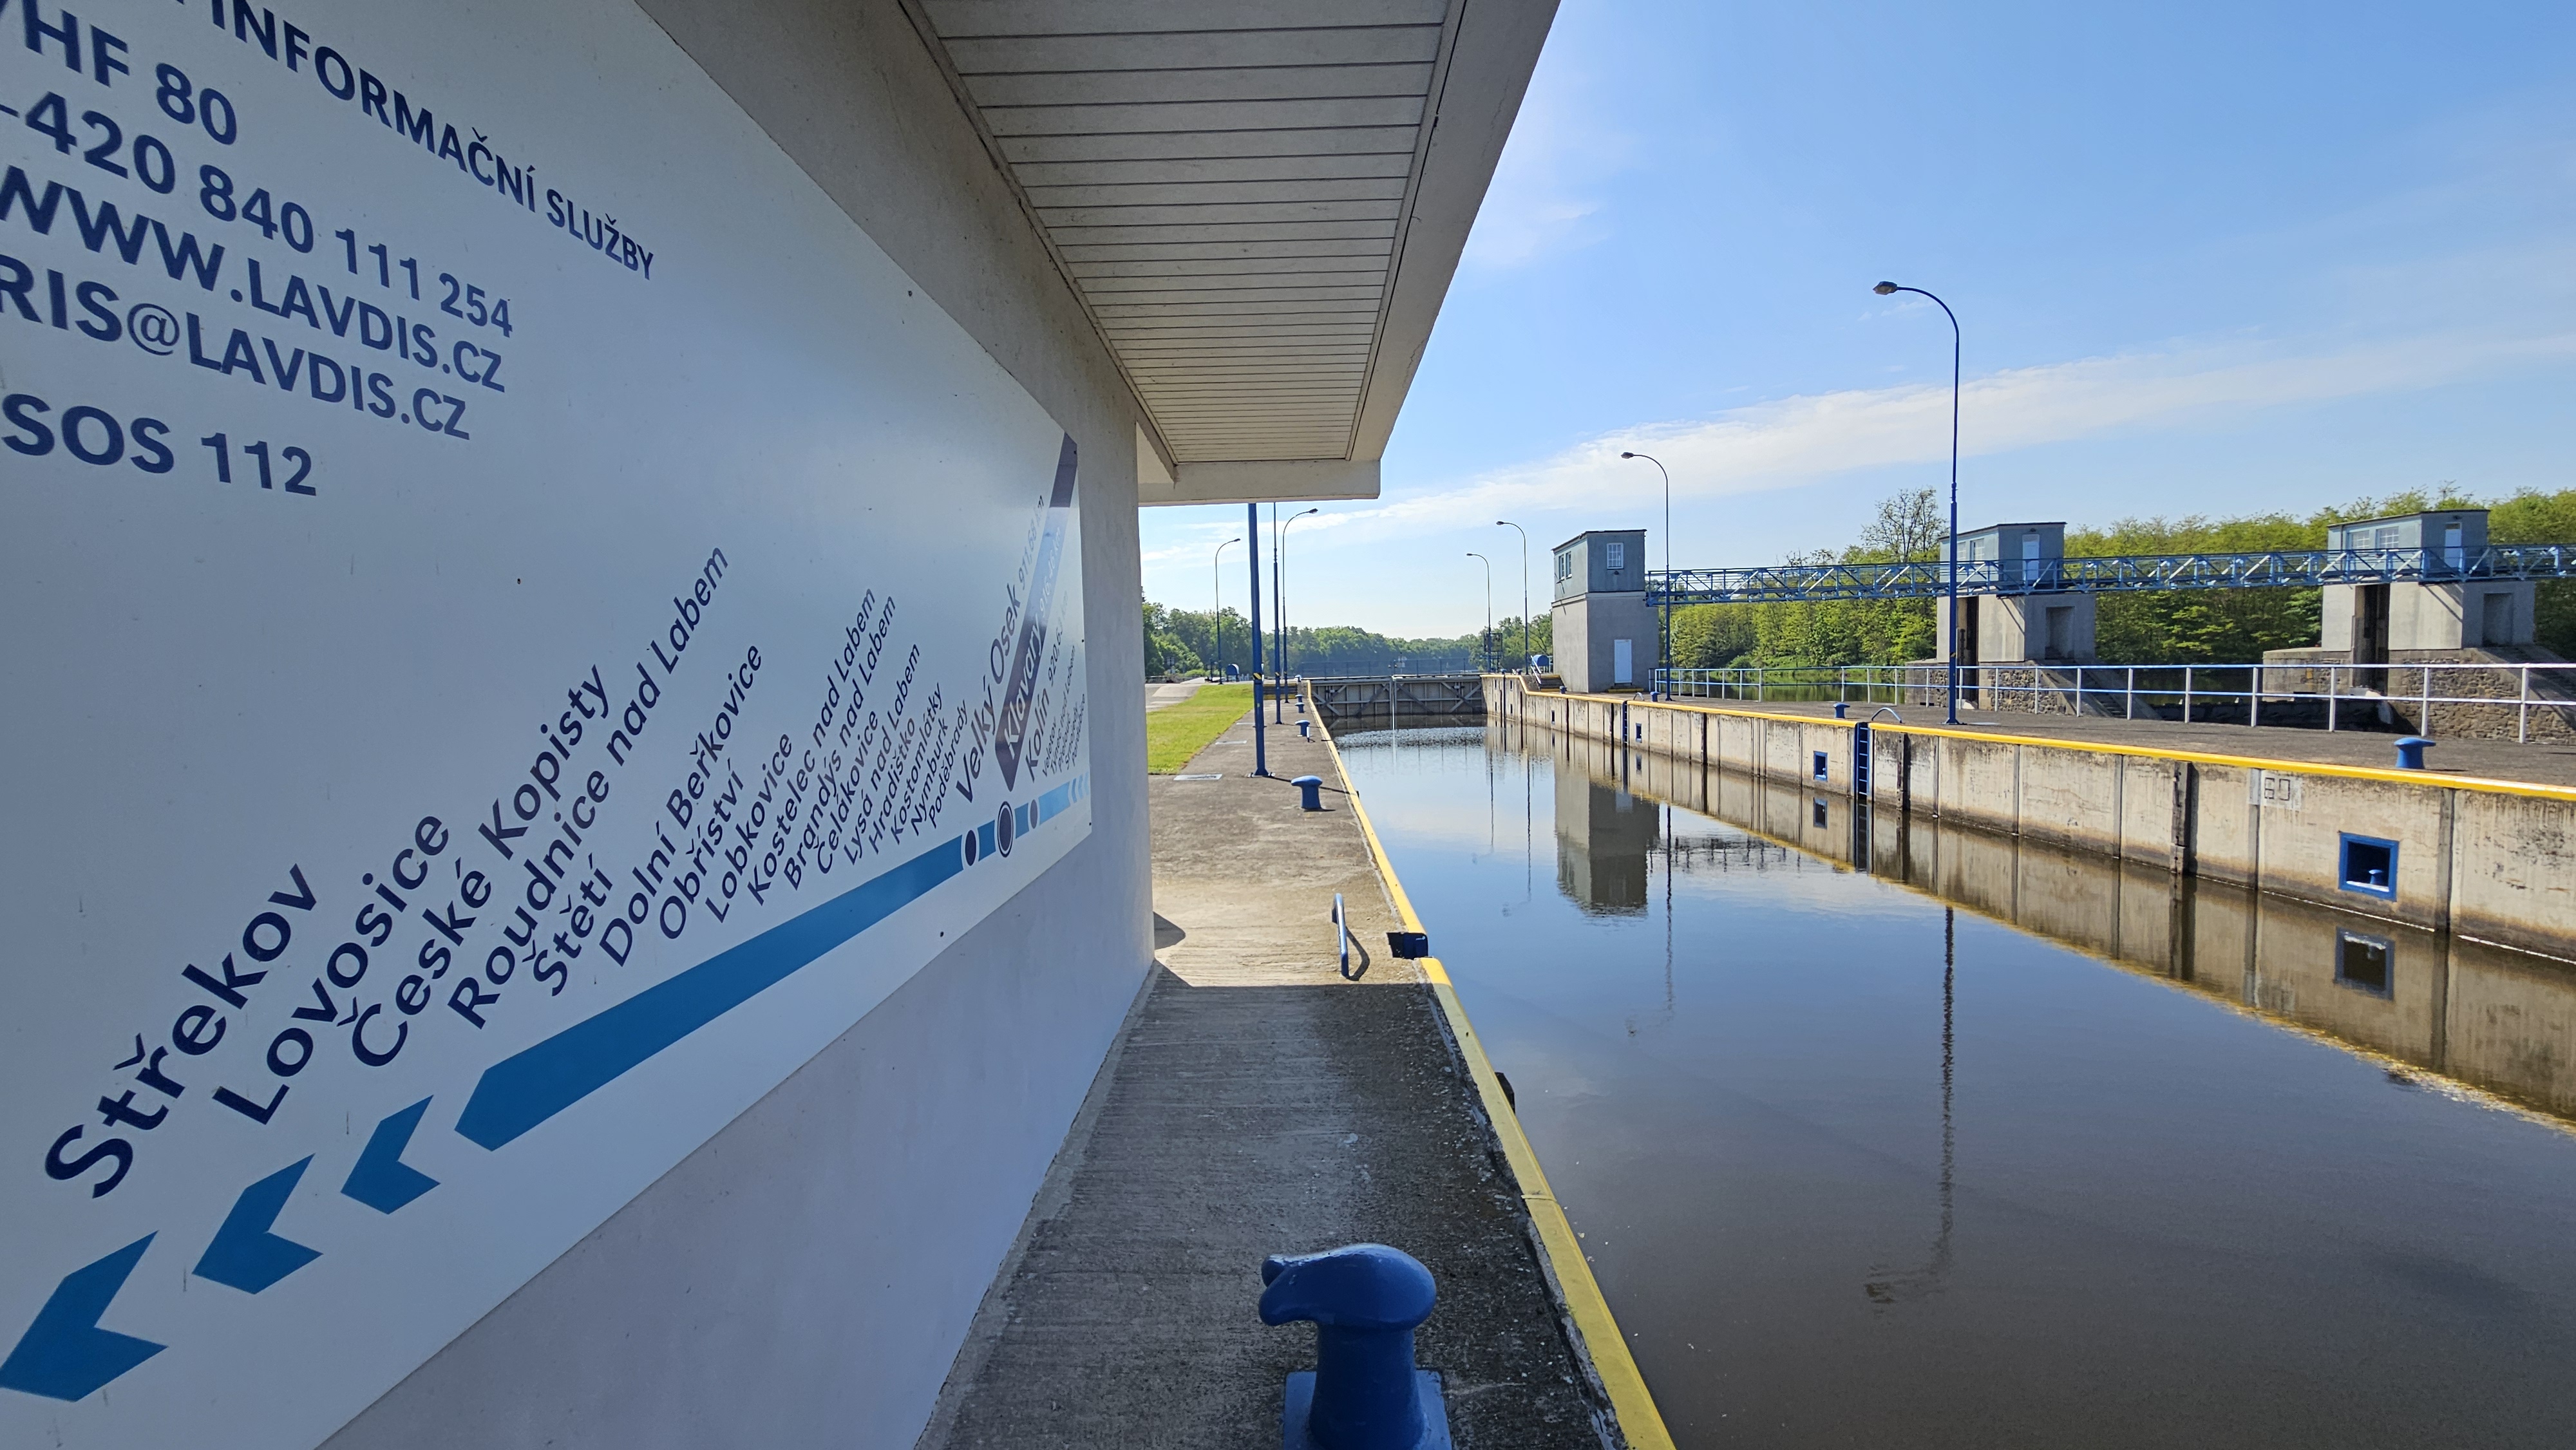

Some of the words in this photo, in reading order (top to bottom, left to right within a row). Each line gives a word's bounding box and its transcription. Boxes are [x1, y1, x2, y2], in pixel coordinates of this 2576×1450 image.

[0, 0, 130, 88] HF
[155, 63, 237, 145] 80
[200, 165, 314, 253] 840
[336, 228, 421, 300] 111
[439, 272, 513, 338] 254
[546, 188, 654, 280] SLUŽBY
[0, 254, 470, 440] RIS@LAVDIS.CZ
[3, 393, 175, 473] SOS
[200, 432, 317, 496] 112
[747, 749, 816, 907] Kostelec
[813, 674, 840, 748] nad
[835, 588, 875, 683] Labem
[783, 749, 841, 890] Brandýs
[839, 678, 864, 748] nad
[859, 596, 896, 686] Labem
[844, 789, 873, 865] Lysá
[870, 725, 891, 792] nad
[887, 644, 920, 731] Labem
[891, 683, 942, 845] Kostomlátky
[928, 699, 967, 829] Poděbrady
[956, 674, 996, 804] Velký
[990, 583, 1021, 684] Osek
[1004, 614, 1043, 760] Klavary
[1026, 688, 1050, 783] Kolín
[447, 769, 609, 1030] Roudnice
[606, 663, 660, 766] nad
[650, 547, 728, 674] Labem
[598, 821, 676, 966] Dolní
[666, 645, 762, 830] Beřkovice
[659, 758, 743, 939] Obříství
[705, 733, 792, 923] Lobkovice
[813, 710, 878, 874] Čelákovice
[869, 717, 915, 854] Hradištko
[911, 717, 948, 836] Nymburk
[2264, 777, 2291, 802] 60
[336, 858, 491, 1067] České
[477, 664, 609, 860] Kopisty
[522, 854, 613, 996] Štětí
[45, 863, 317, 1199] Střekov
[212, 815, 449, 1125] Lovosice
